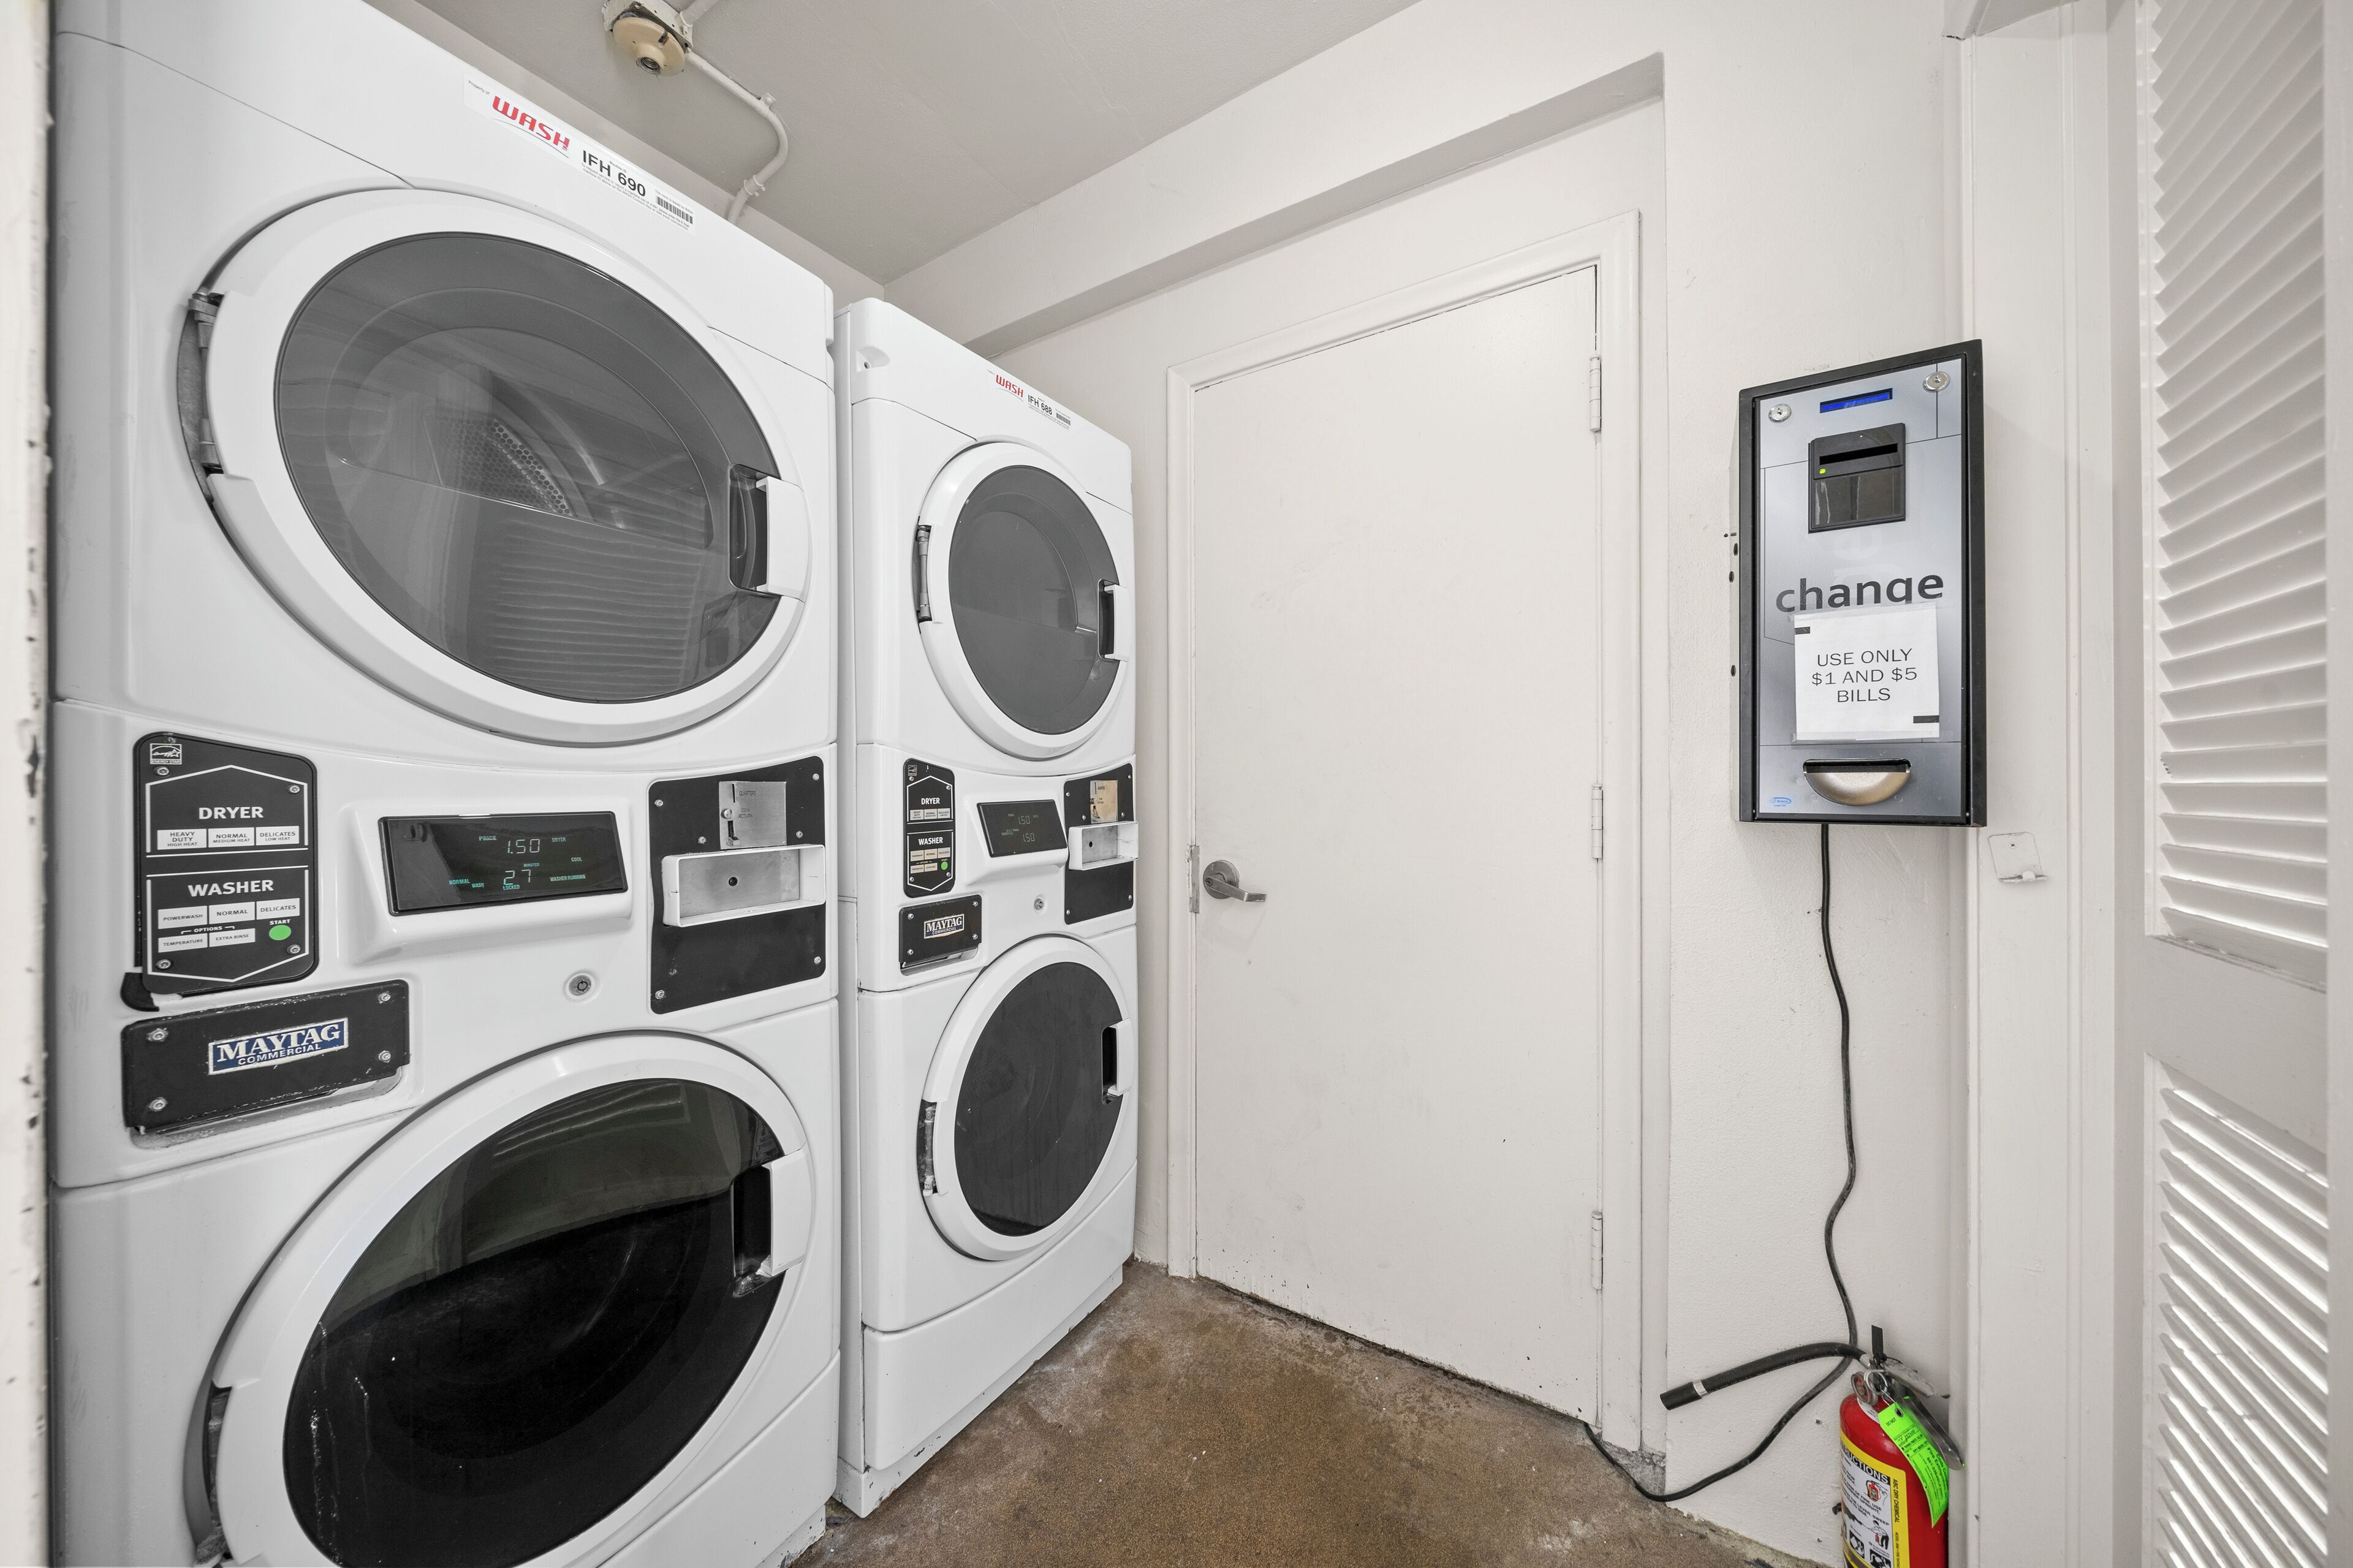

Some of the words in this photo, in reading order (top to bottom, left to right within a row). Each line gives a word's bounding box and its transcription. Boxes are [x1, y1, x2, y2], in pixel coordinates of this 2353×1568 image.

[492, 96, 570, 150] WASH
[583, 150, 610, 177] IFH
[618, 172, 645, 197] 690
[996, 374, 1023, 398] WASH
[1028, 394, 1039, 407] IFH
[1041, 403, 1053, 415] 688
[1776, 574, 1944, 612] change
[1817, 652, 1854, 667] USE
[1861, 648, 1912, 664] ONLY
[1811, 672, 1836, 686] $1
[1842, 668, 1884, 684] AND
[1892, 667, 1917, 682] $5
[1837, 687, 1891, 703] BILLS
[199, 806, 263, 819] DRYER
[507, 839, 540, 854] 1.50
[918, 837, 944, 846] WASHER
[188, 879, 274, 897] WASHER
[926, 917, 962, 932] MAYTAG
[217, 1024, 341, 1062] MAYTAG
[238, 1043, 321, 1066] COMMERCIAL
[1841, 1441, 1889, 1483] TRUCTIONS
[1872, 1503, 1882, 1512] USE
[1872, 1515, 1889, 1525] SWEEP
